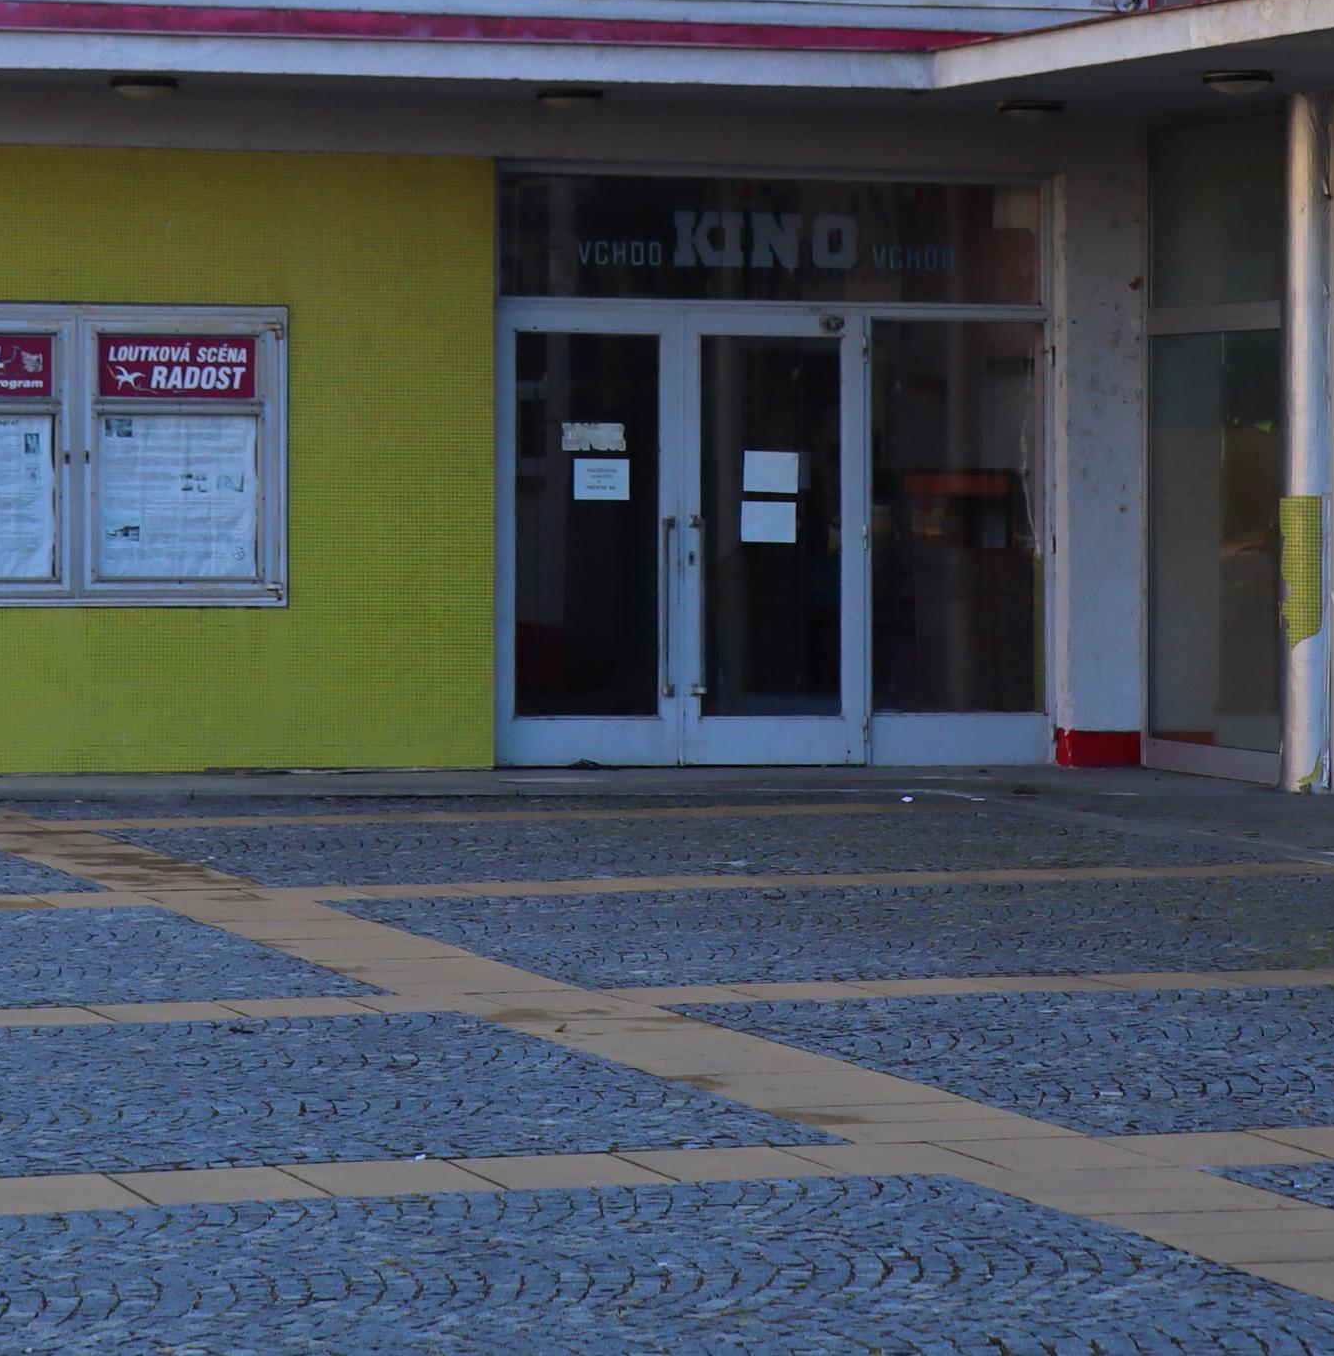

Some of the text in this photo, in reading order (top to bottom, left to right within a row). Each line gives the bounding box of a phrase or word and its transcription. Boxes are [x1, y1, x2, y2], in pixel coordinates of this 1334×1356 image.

[673, 209, 859, 270] KINO
[107, 342, 248, 364] LOUTKOVÁ SCÉNA
[150, 365, 247, 390] RADOST
